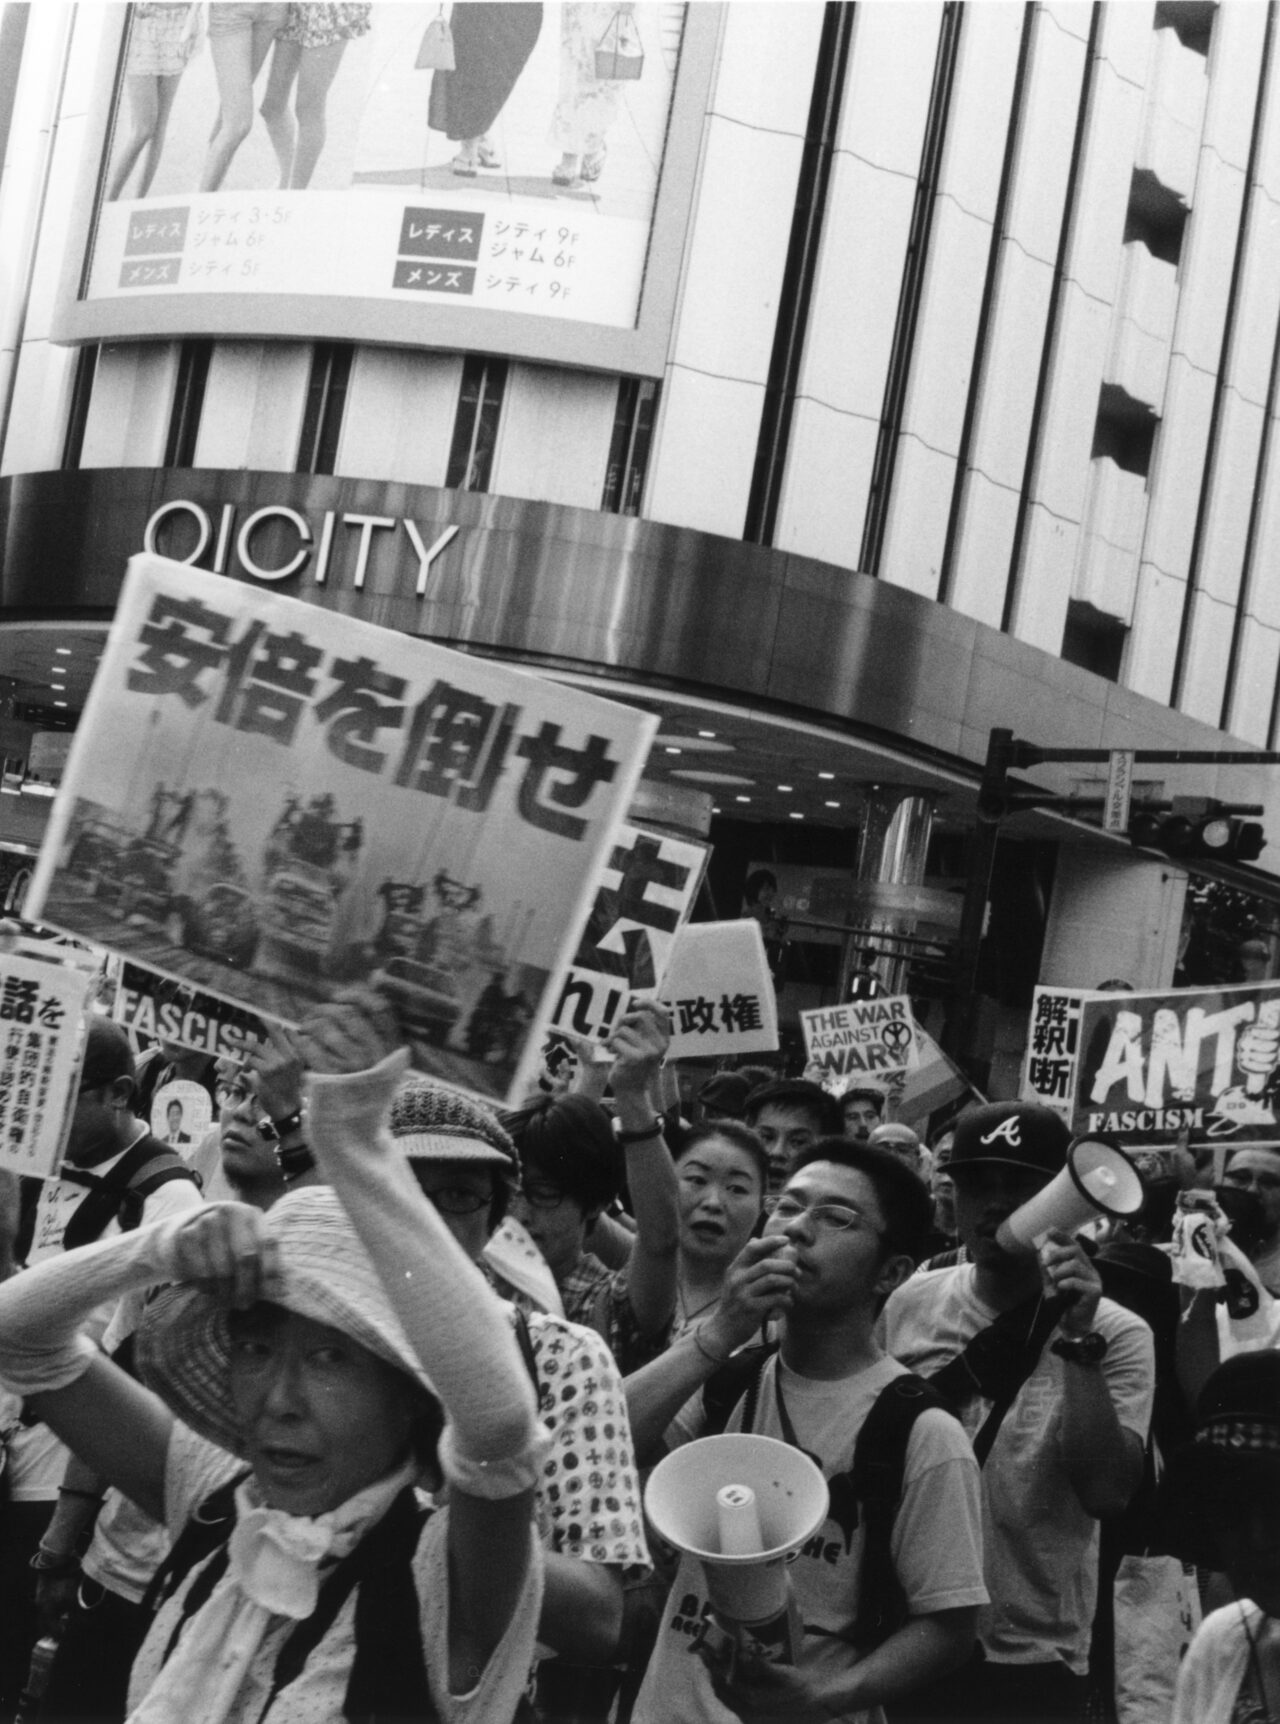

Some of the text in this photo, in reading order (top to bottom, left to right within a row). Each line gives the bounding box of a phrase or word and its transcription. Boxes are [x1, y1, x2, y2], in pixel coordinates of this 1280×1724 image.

[132, 221, 182, 240] レディス
[408, 222, 474, 244] レディス
[494, 220, 547, 241] シティ
[490, 241, 545, 264] ジャム
[128, 264, 170, 282] メンズ
[406, 268, 463, 287] メンズ
[486, 274, 539, 295] シティ
[126, 592, 620, 842] 安倍を倒せ
[805, 1001, 907, 1033] THE WAR
[810, 1025, 880, 1050] AGAINST
[1088, 1108, 1203, 1133] FASCISM
